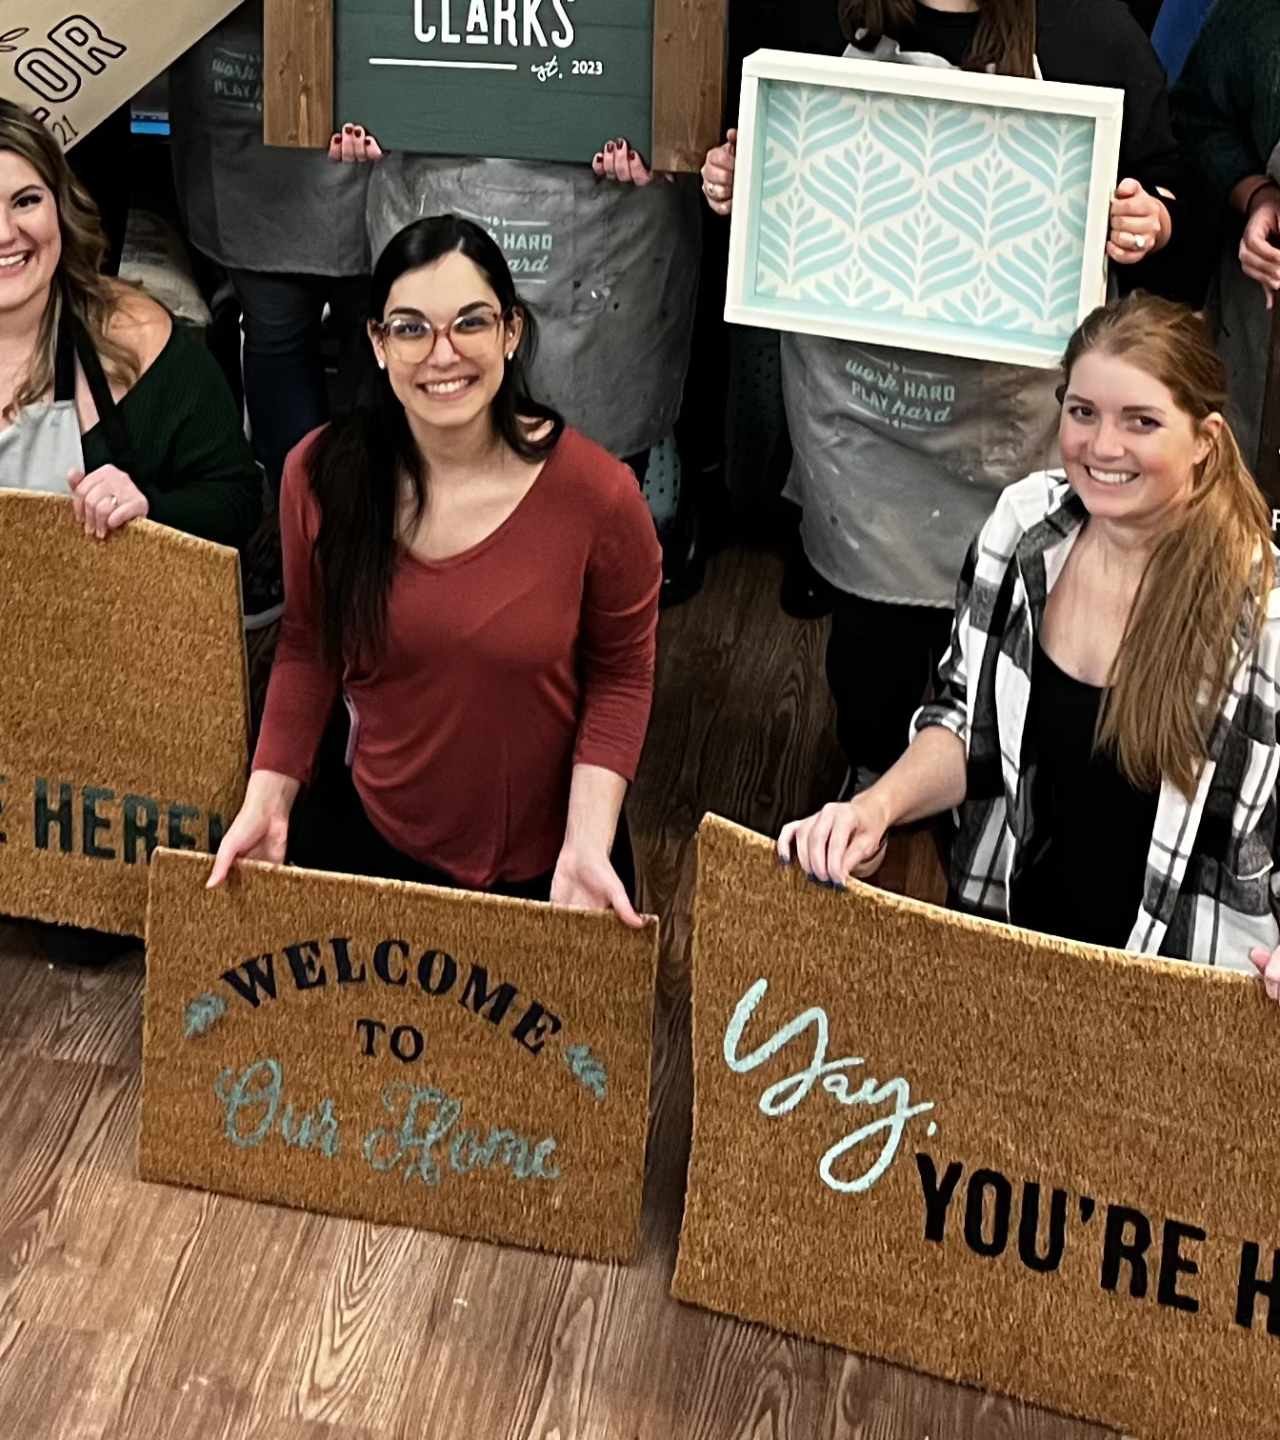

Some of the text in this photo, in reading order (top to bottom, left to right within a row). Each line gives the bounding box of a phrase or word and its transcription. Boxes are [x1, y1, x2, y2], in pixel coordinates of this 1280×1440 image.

[571, 59, 604, 76] 2023
[503, 231, 553, 252] HARD
[507, 253, 550, 274] ard
[845, 359, 957, 403] work HARD
[852, 380, 953, 424] PLAY hard
[220, 936, 564, 1057] WELCOME
[355, 1017, 425, 1064] TO
[213, 1057, 562, 1187] Our Home
[914, 1151, 1207, 1314] YOU'RE
